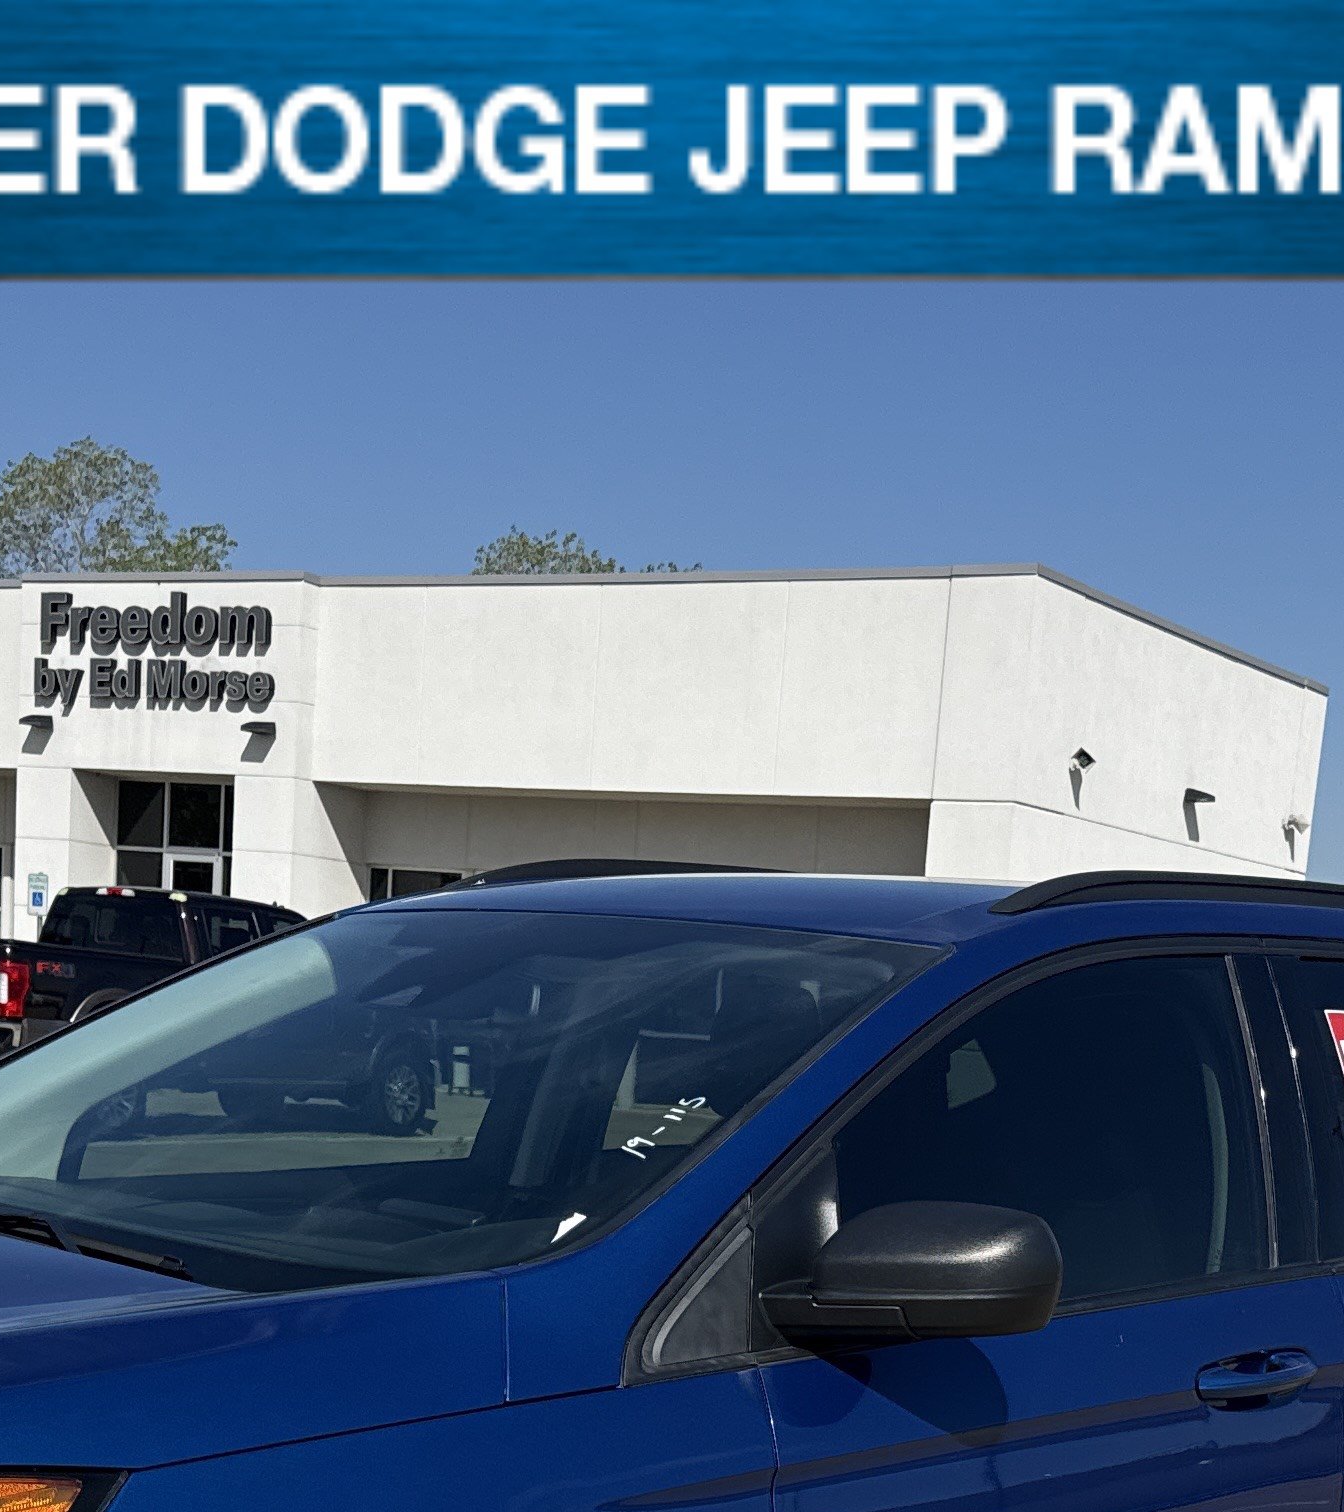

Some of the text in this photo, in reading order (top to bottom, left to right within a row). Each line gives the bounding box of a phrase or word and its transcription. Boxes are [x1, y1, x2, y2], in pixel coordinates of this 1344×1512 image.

[40, 591, 273, 649] Freedom
[34, 658, 276, 711] by Ed Morse
